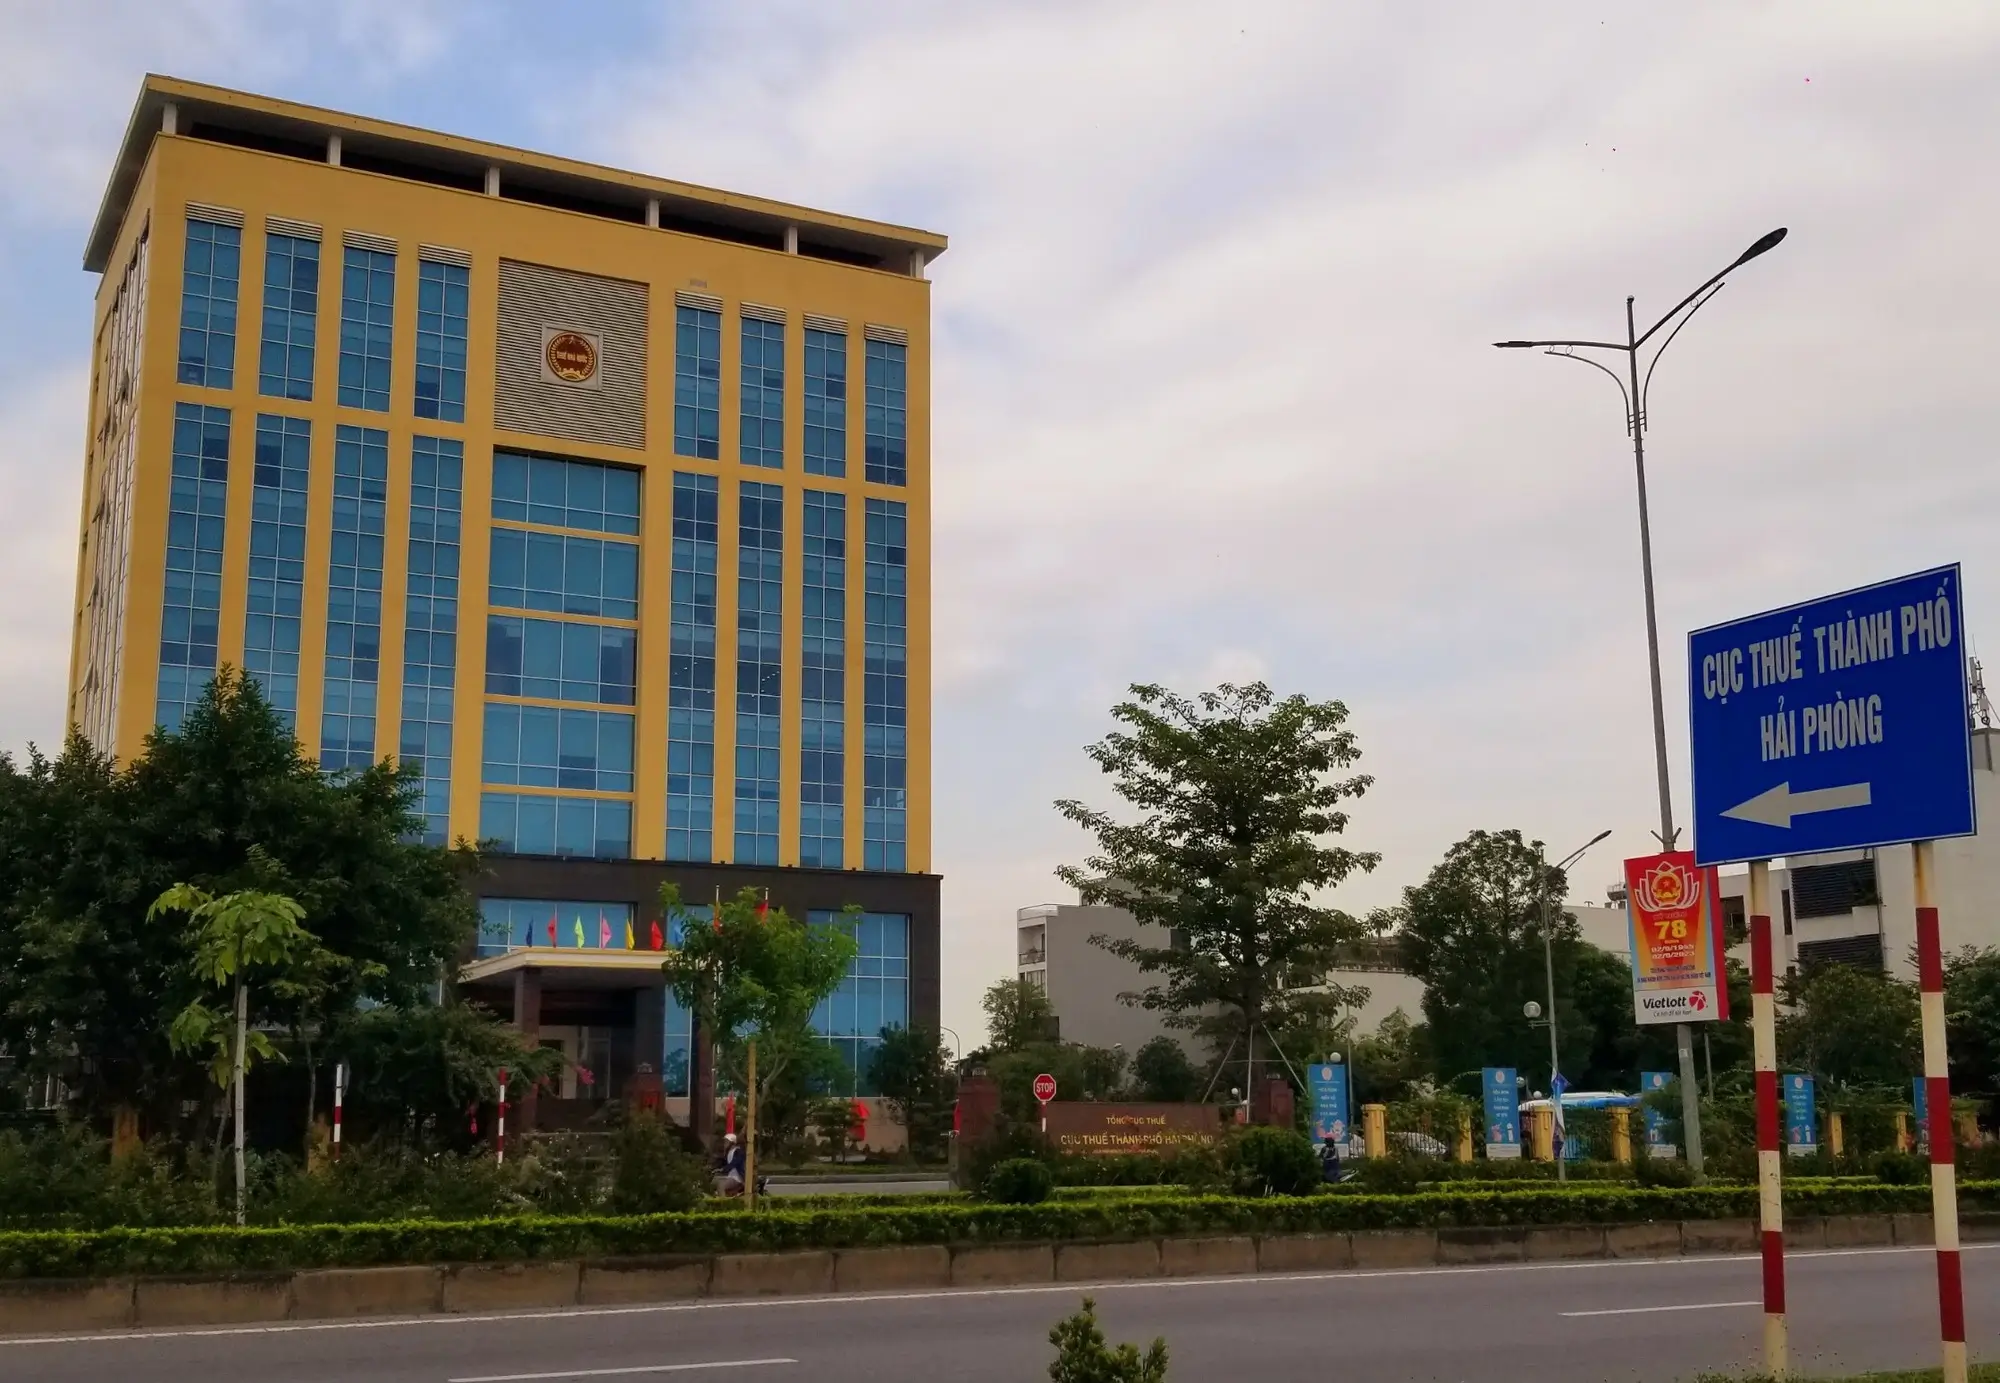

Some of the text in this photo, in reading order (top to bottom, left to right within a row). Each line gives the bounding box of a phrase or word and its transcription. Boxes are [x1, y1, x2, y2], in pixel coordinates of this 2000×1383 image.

[1703, 577, 1952, 704] CỤC THUẾ THÀNH PHỐ
[1760, 691, 1883, 762] HẢI PHÒNG
[1653, 919, 1687, 940] 78
[1642, 996, 1687, 1009] Vietlott
[1036, 1082, 1054, 1093] STOP
